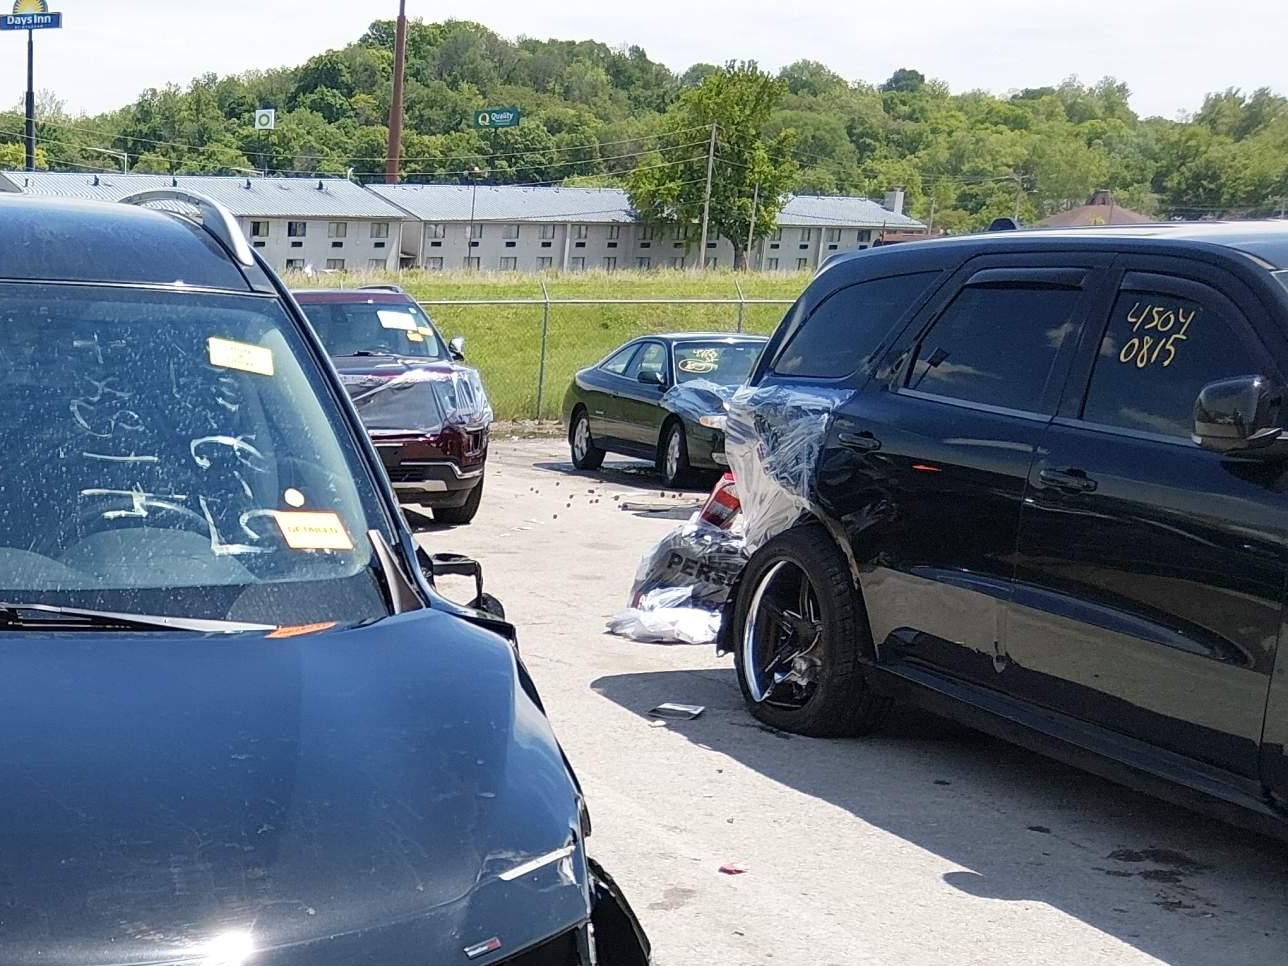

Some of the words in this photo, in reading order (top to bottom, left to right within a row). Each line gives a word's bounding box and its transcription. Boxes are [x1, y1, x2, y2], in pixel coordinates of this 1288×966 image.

[7, 15, 33, 25] Days
[33, 14, 52, 24] Inn
[478, 112, 490, 126] Q
[490, 111, 514, 122] Quality
[1127, 302, 1195, 334] 4504
[1119, 333, 1187, 368] 0815
